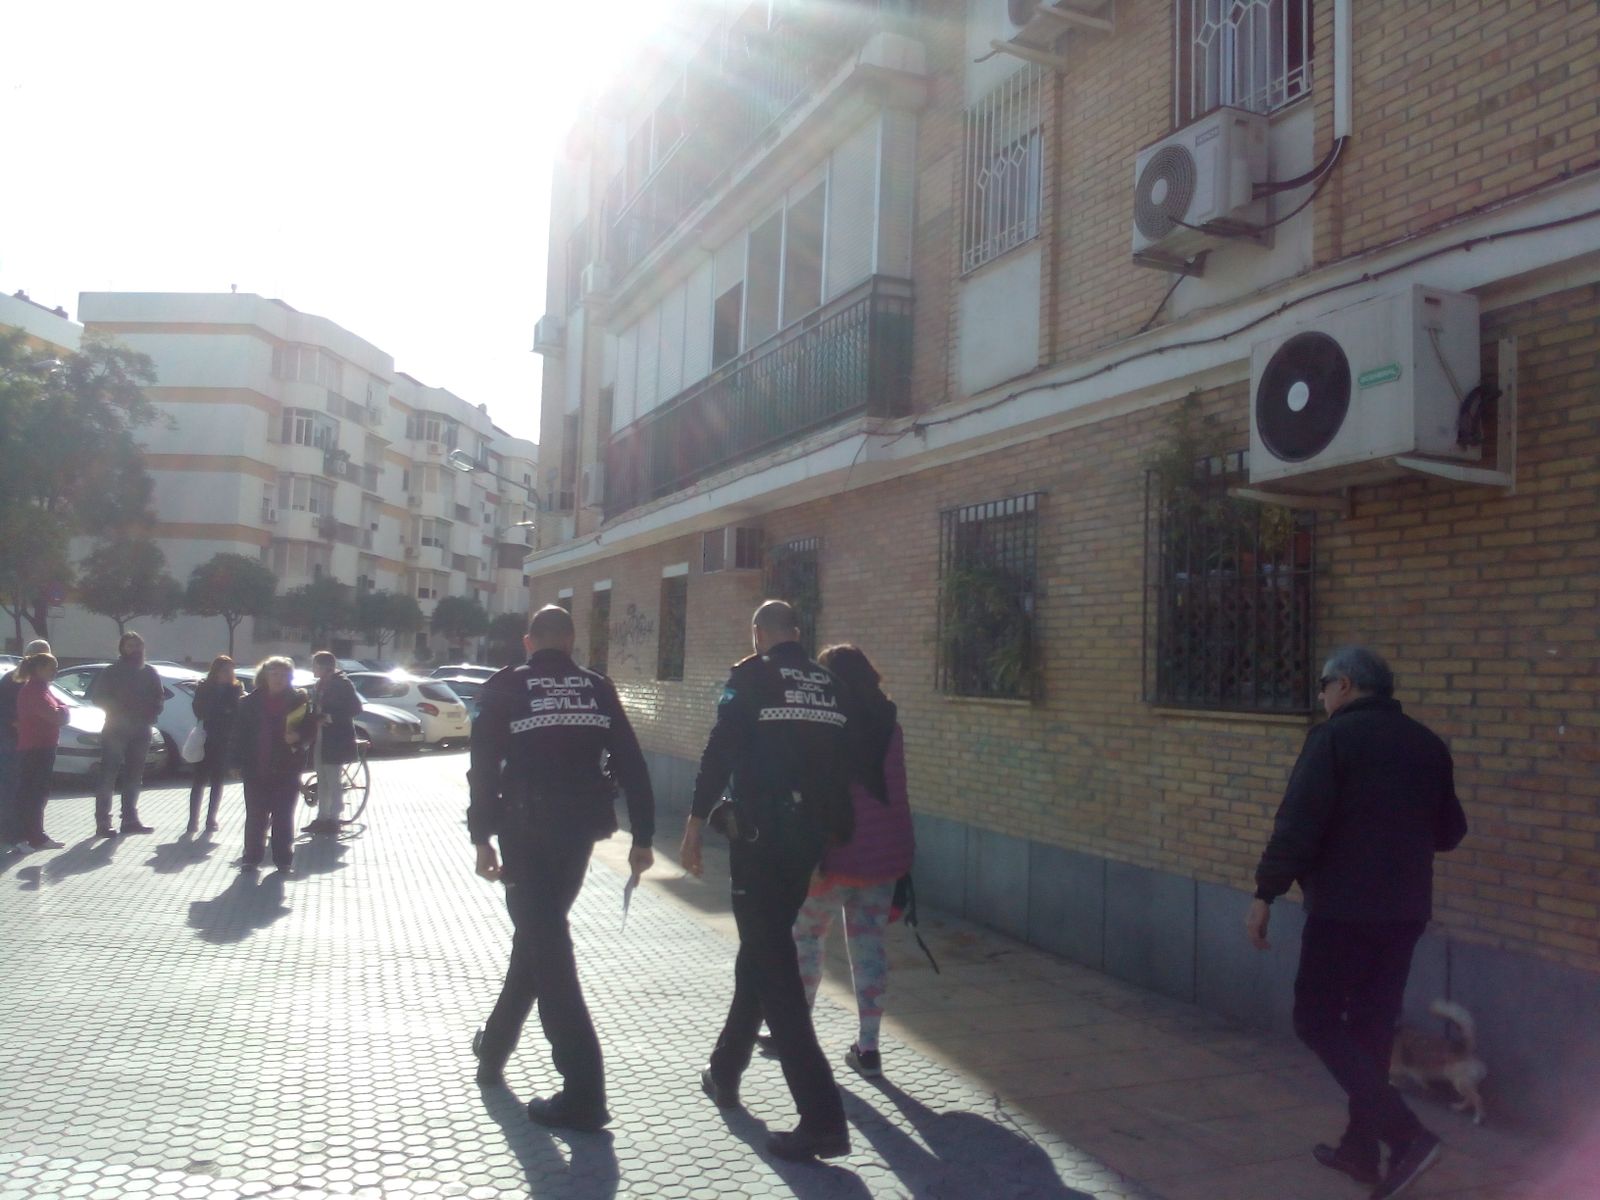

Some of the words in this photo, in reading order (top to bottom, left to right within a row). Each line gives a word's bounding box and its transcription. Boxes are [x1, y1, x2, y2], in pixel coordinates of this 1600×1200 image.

[527, 676, 593, 690] POLICIA
[546, 688, 581, 696] LOCAL
[785, 690, 837, 708] SEVILLA
[530, 697, 599, 712] SEVILLA
